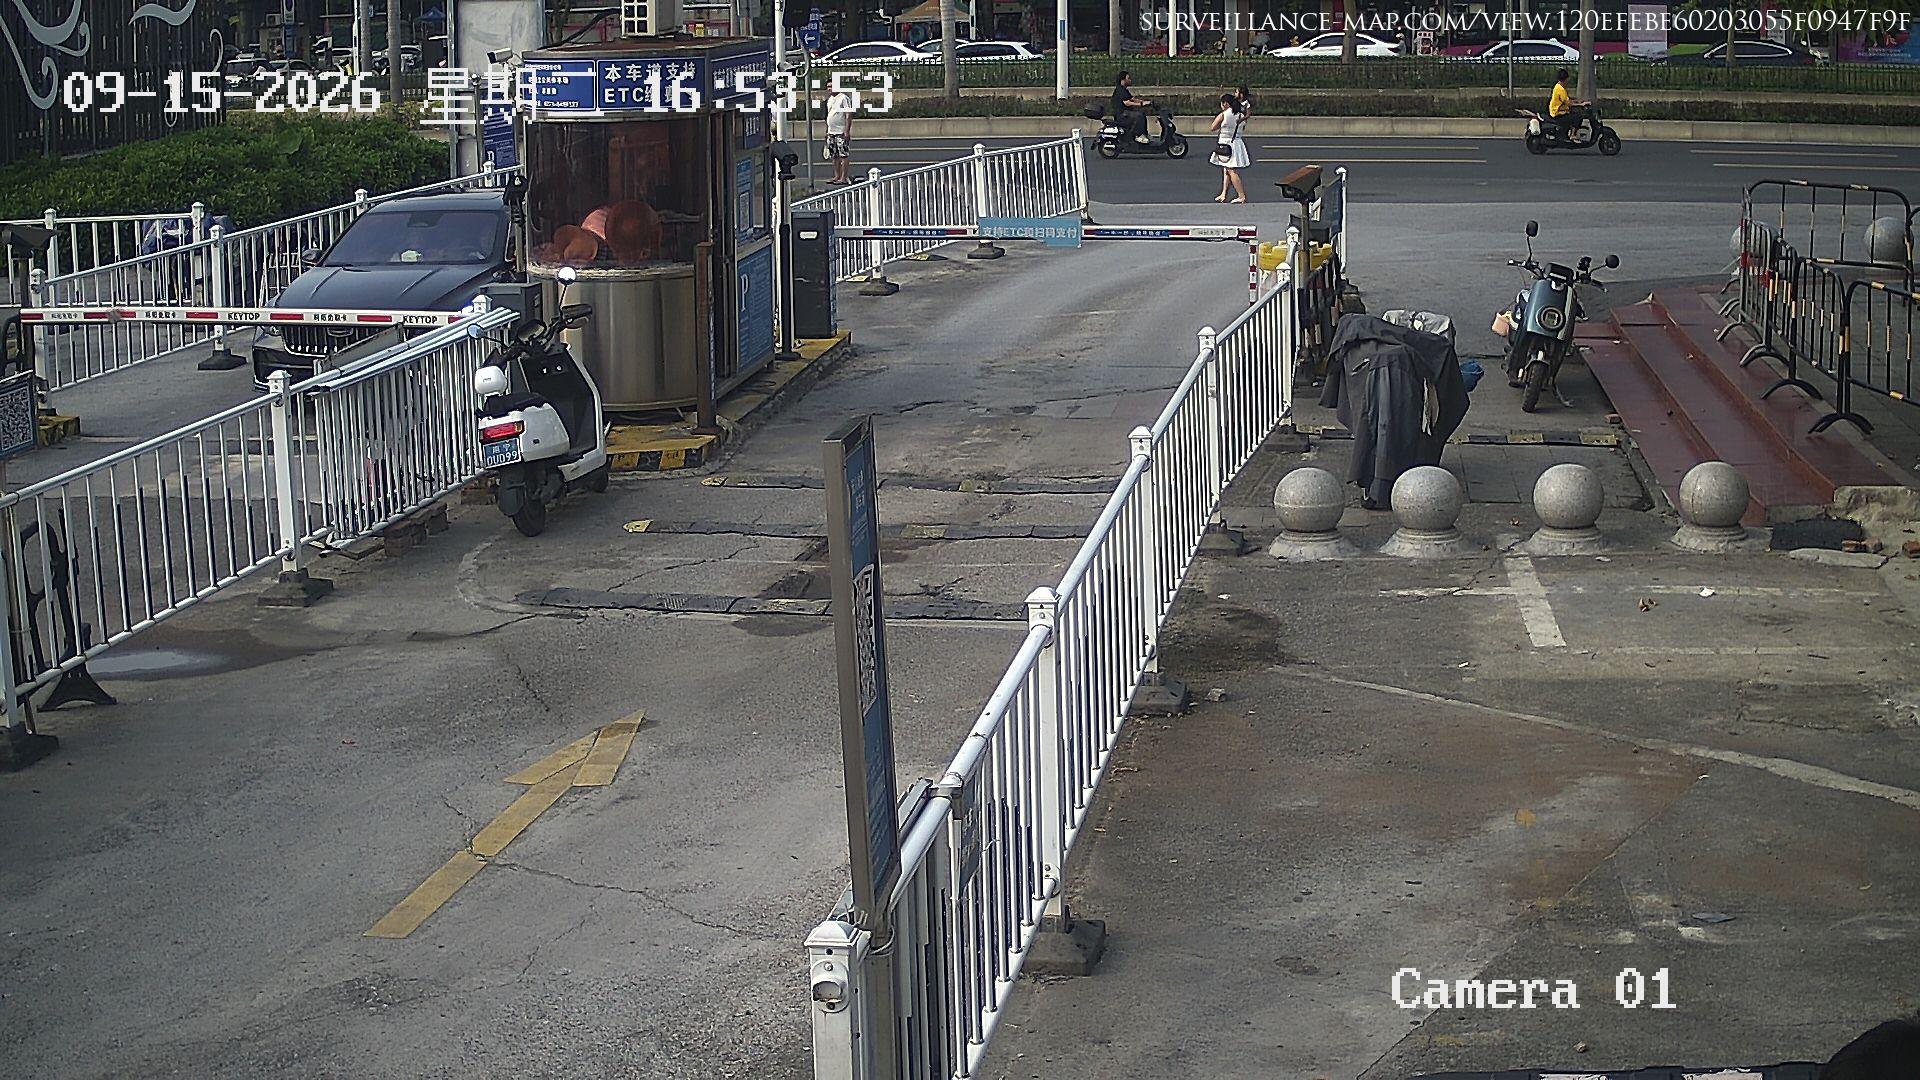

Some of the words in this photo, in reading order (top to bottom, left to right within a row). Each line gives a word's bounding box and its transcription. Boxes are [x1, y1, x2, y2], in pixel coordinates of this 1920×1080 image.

[604, 61, 696, 82] 本车道支持
[227, 312, 260, 321] KEYTOP
[402, 315, 438, 324] KEYTOP
